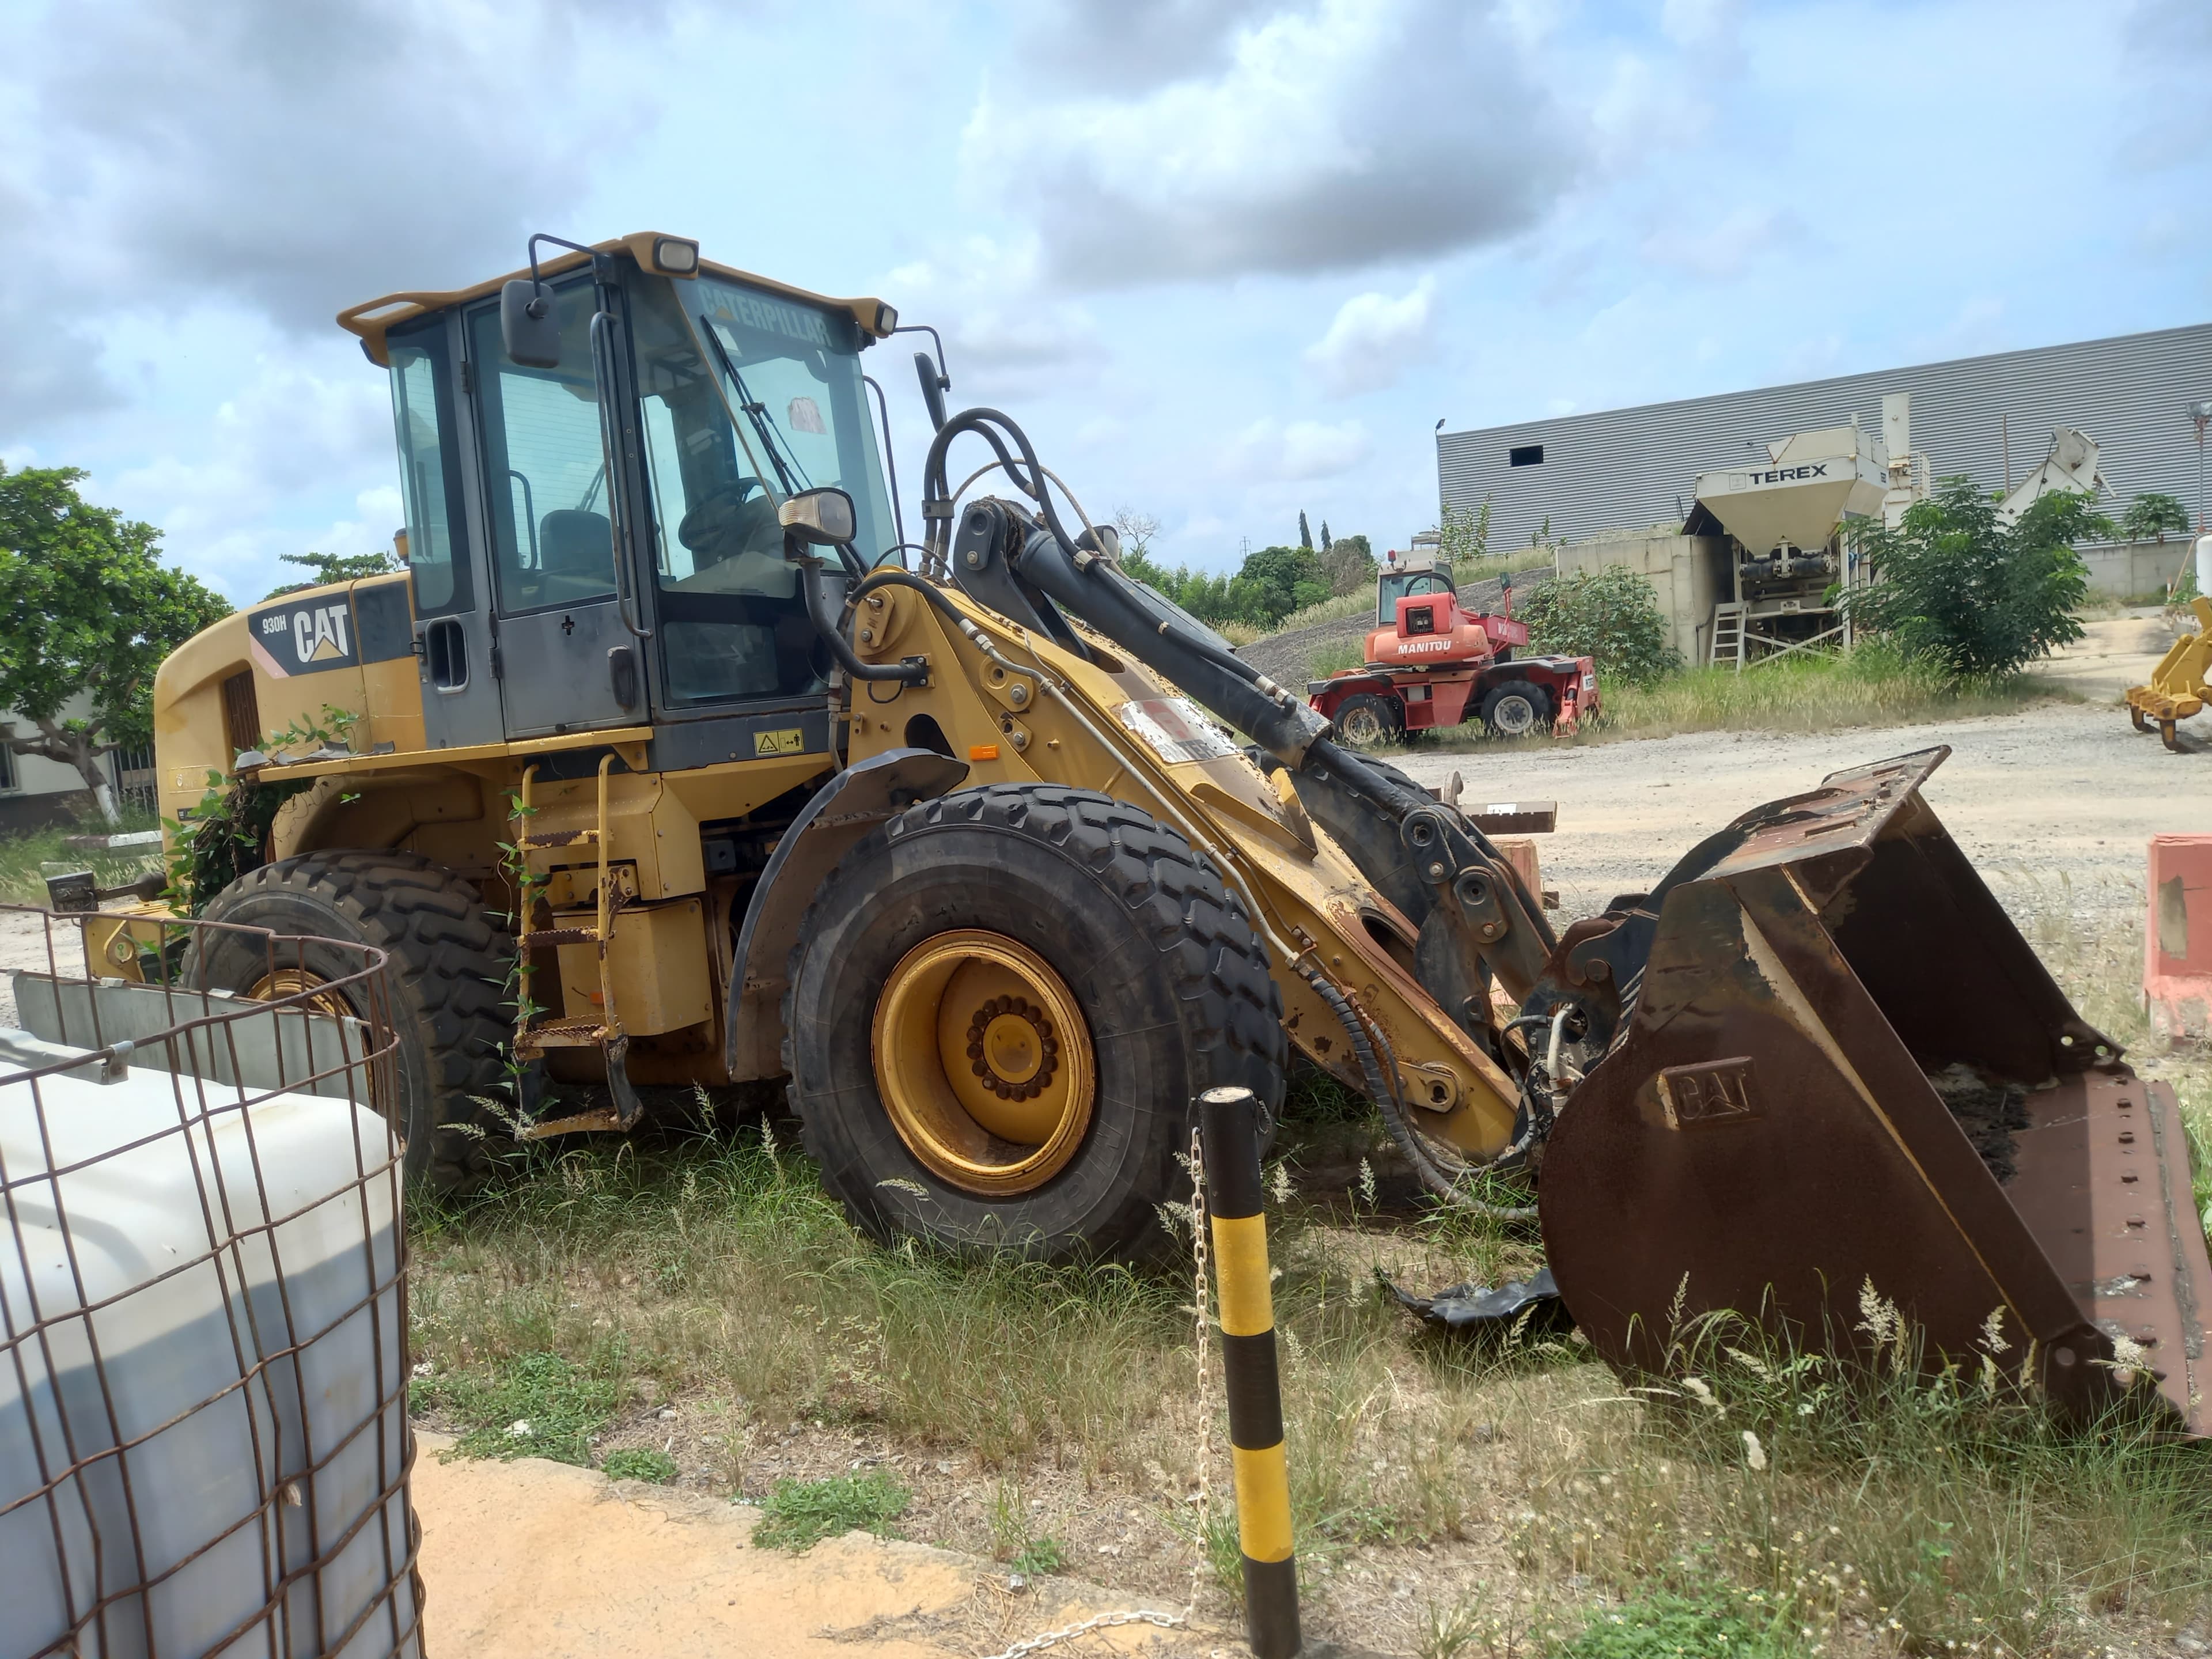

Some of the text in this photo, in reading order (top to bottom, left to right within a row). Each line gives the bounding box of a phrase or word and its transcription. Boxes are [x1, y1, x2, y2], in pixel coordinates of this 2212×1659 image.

[698, 284, 832, 347] CATERPILLAR
[1749, 464, 1828, 484] TEREX
[263, 615, 287, 634] 930H
[293, 604, 349, 663] CAT
[1398, 641, 1452, 654] MANITOU
[1677, 1067, 1750, 1120] CAT
